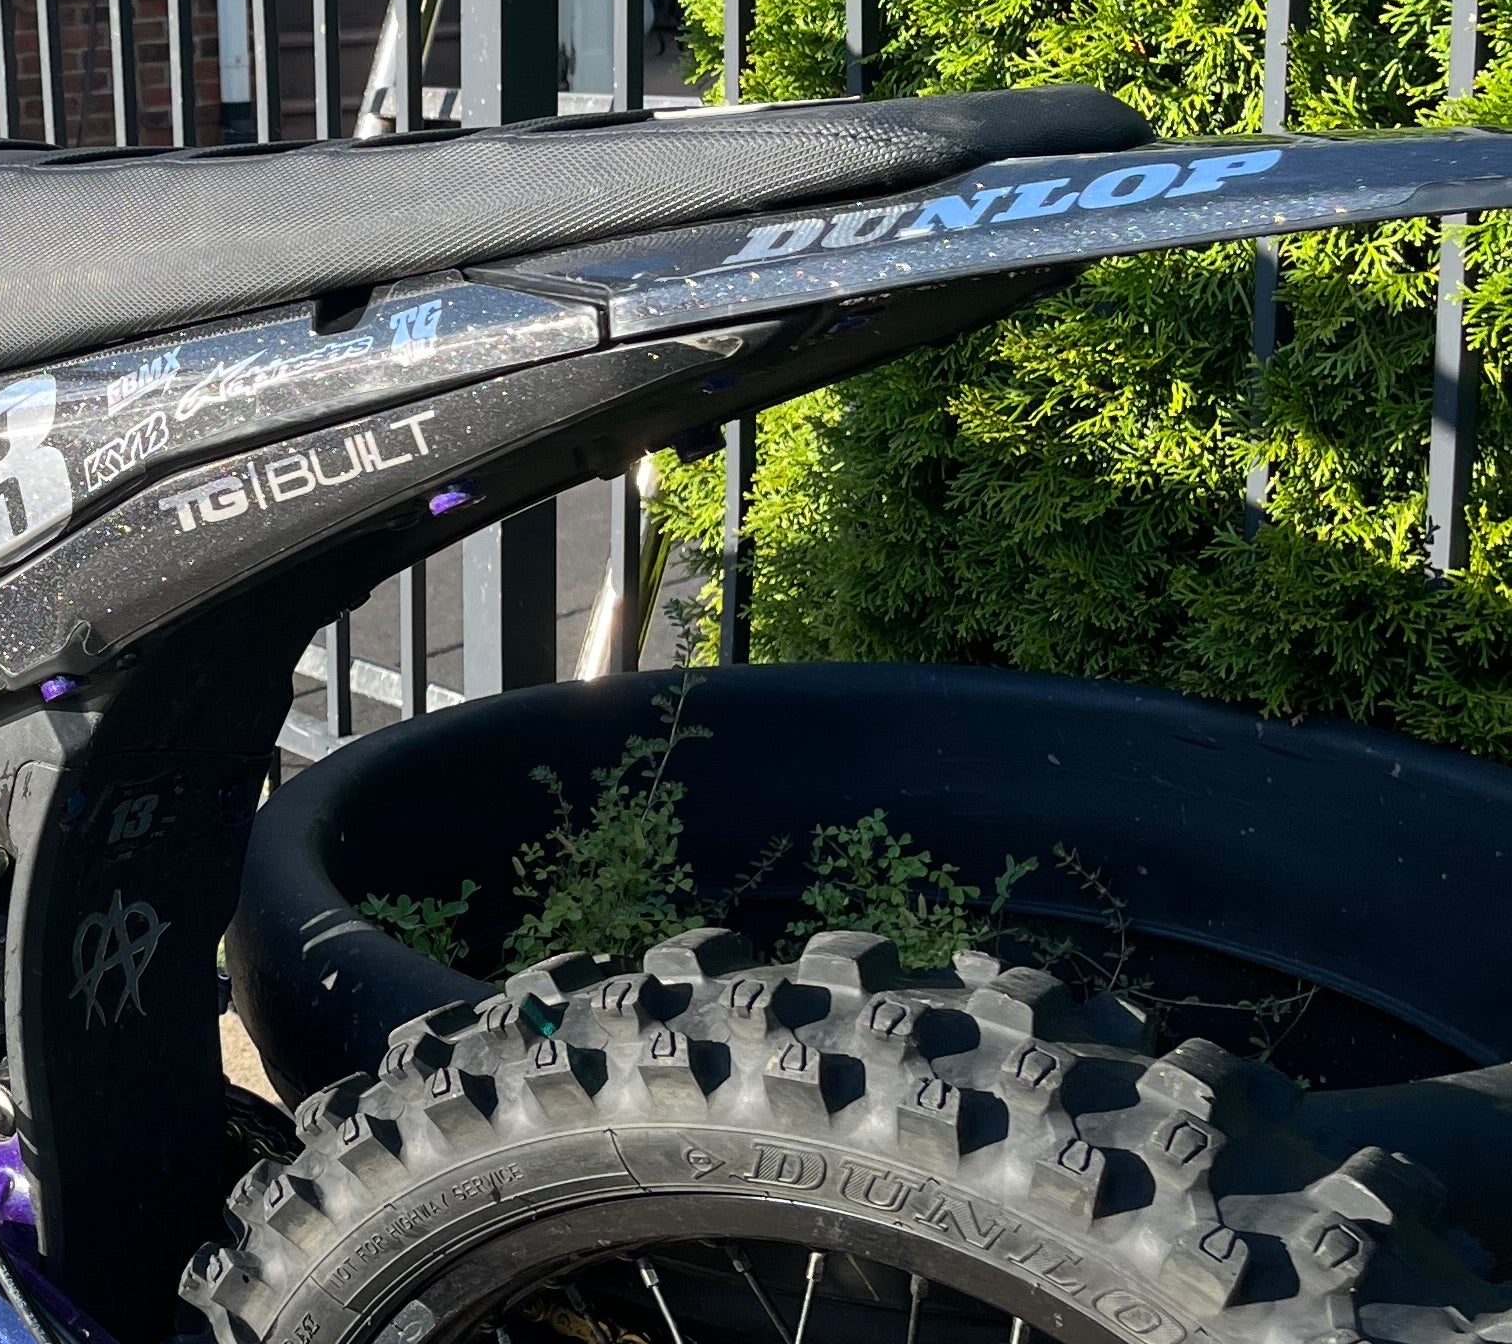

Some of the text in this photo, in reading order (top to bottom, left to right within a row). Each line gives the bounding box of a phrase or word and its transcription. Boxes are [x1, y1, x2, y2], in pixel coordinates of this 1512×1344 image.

[723, 149, 1284, 265] DUNLOP
[390, 298, 443, 355] TG
[84, 410, 169, 492] KYB
[106, 793, 161, 845] 13
[355, 1232, 388, 1263] FOR
[386, 1193, 449, 1241] HIGHWAY
[451, 1162, 524, 1201] SERVICE
